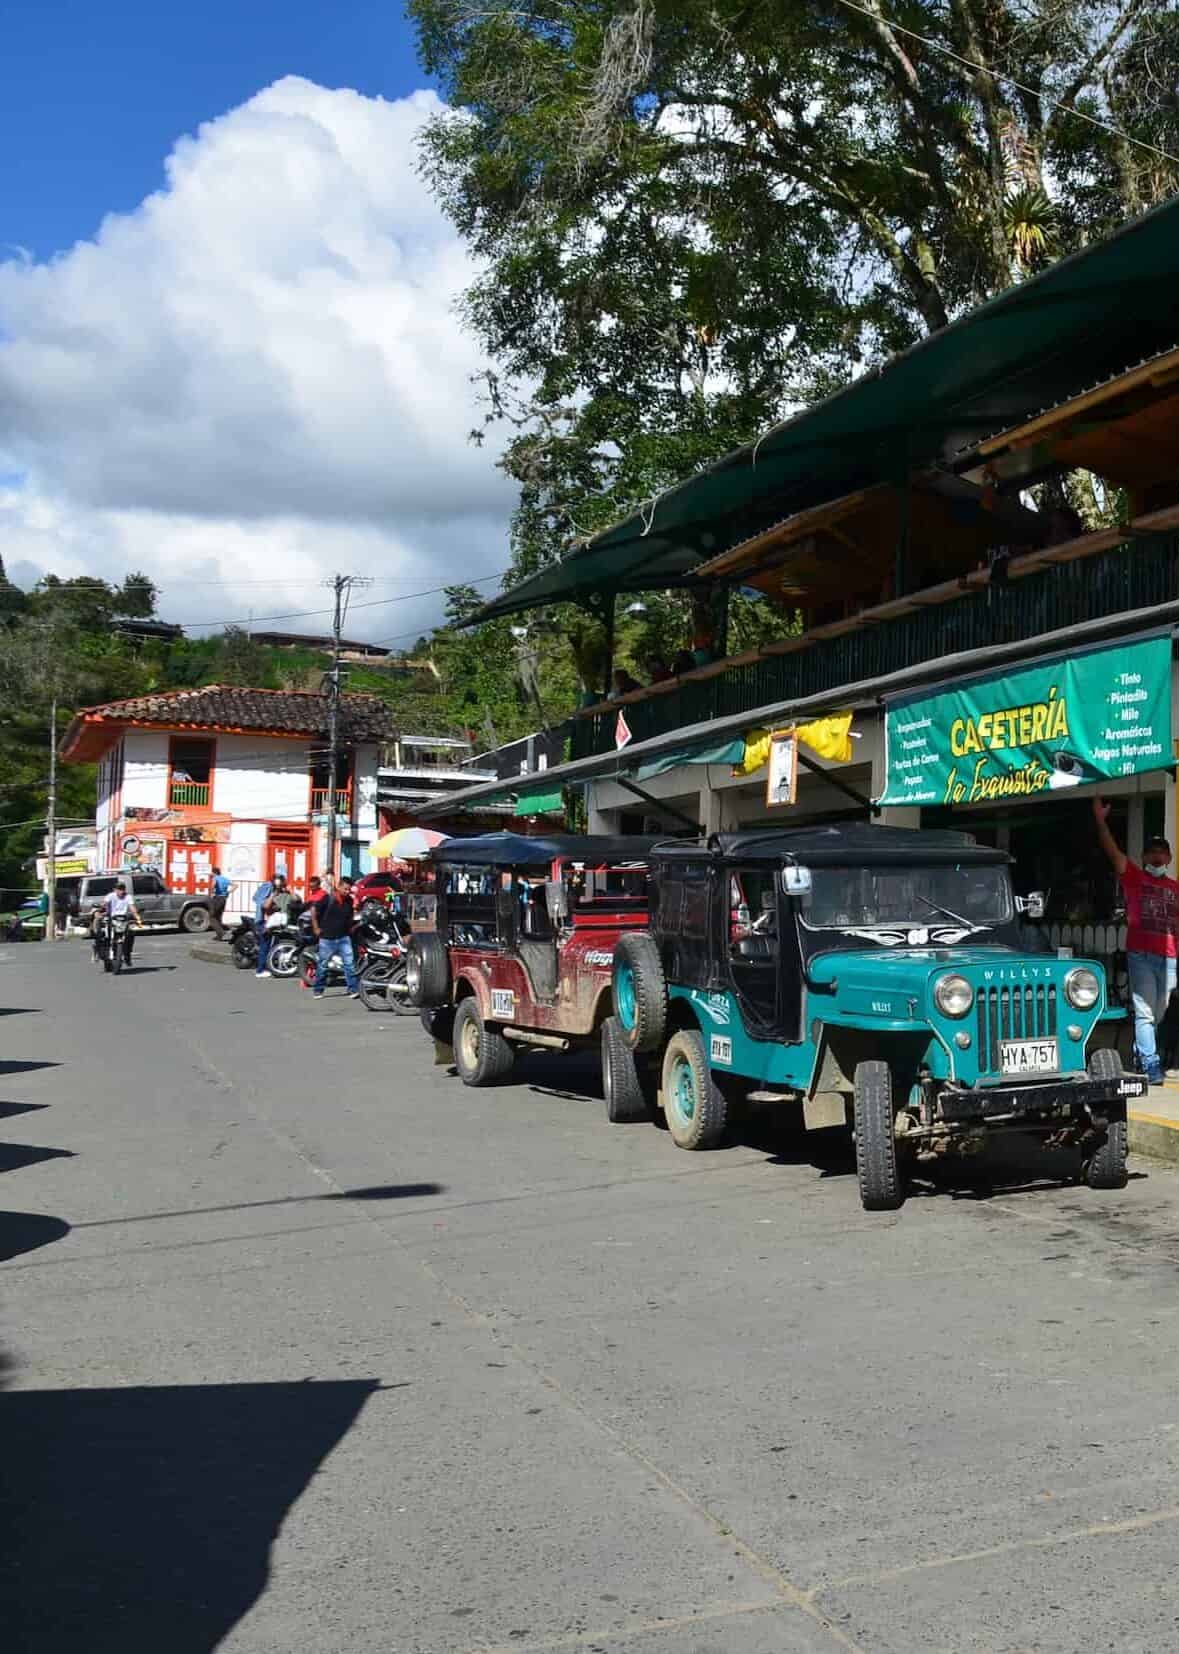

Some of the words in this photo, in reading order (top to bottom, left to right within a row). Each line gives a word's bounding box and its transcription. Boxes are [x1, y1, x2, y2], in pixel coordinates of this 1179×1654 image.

[1120, 672, 1142, 686] Tinto
[950, 686, 1069, 757] CAFETERÍA
[1105, 724, 1153, 740] Aromáticas
[1121, 740, 1162, 757] Naturales
[984, 967, 1052, 980] WILLYS
[1001, 1047, 1027, 1066] HYA
[1031, 1045, 1056, 1064] 757
[1117, 1079, 1143, 1096] Jeep
